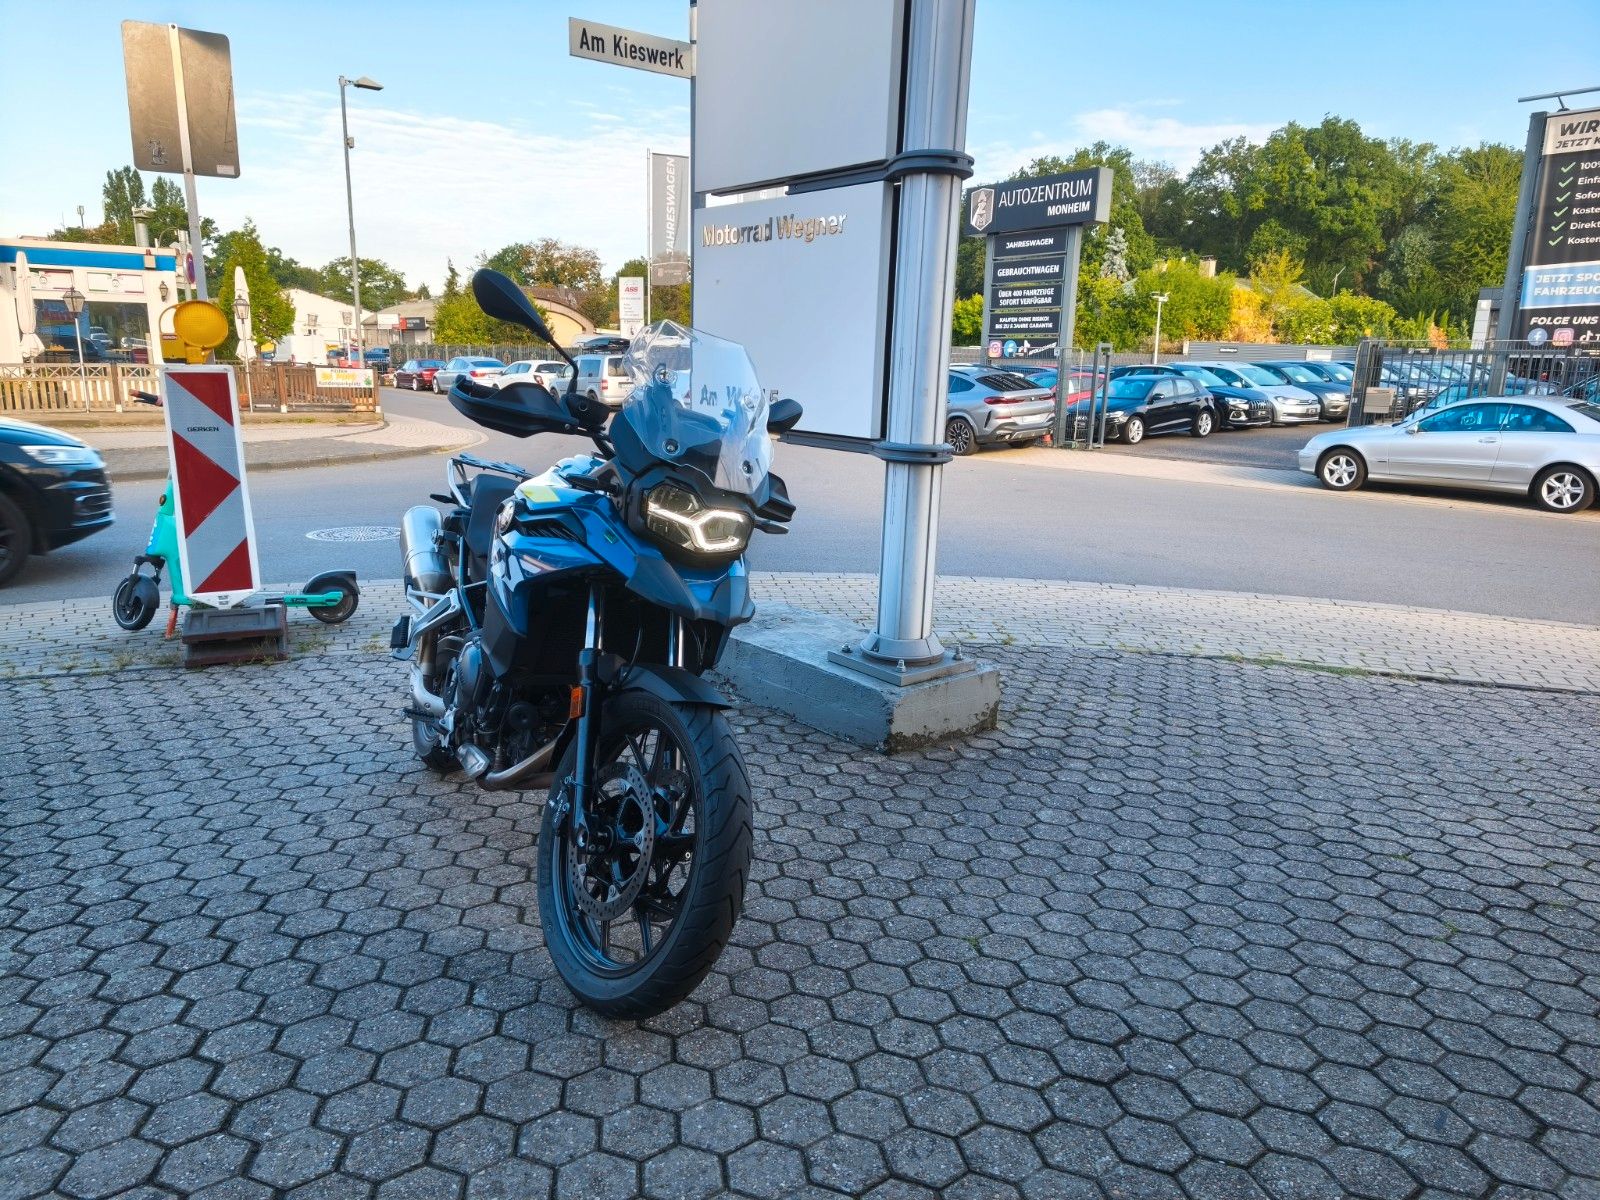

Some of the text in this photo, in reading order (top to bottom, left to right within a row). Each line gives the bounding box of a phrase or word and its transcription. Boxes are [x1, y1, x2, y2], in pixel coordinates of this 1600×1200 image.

[580, 27, 684, 70] Am Kieswerk
[1560, 119, 1600, 136] WIR
[1555, 137, 1592, 149] JETZT
[998, 178, 1093, 208] AUTOZENTRUM
[664, 156, 675, 256] JAHRESWAGEN
[1047, 201, 1091, 216] MONHEIM
[702, 213, 847, 247] Motorrad Wegner
[1006, 238, 1054, 249] JAHRESWAGEN
[997, 265, 1060, 277] GEBRAUCHTWAGEN
[1535, 274, 1573, 284] JETZT
[998, 290, 1012, 298] ÜBER
[1023, 288, 1055, 296] FAHRZEUGE
[1020, 296, 1052, 304] VERFÜGBAR
[1530, 316, 1599, 325] FOLGE UNS
